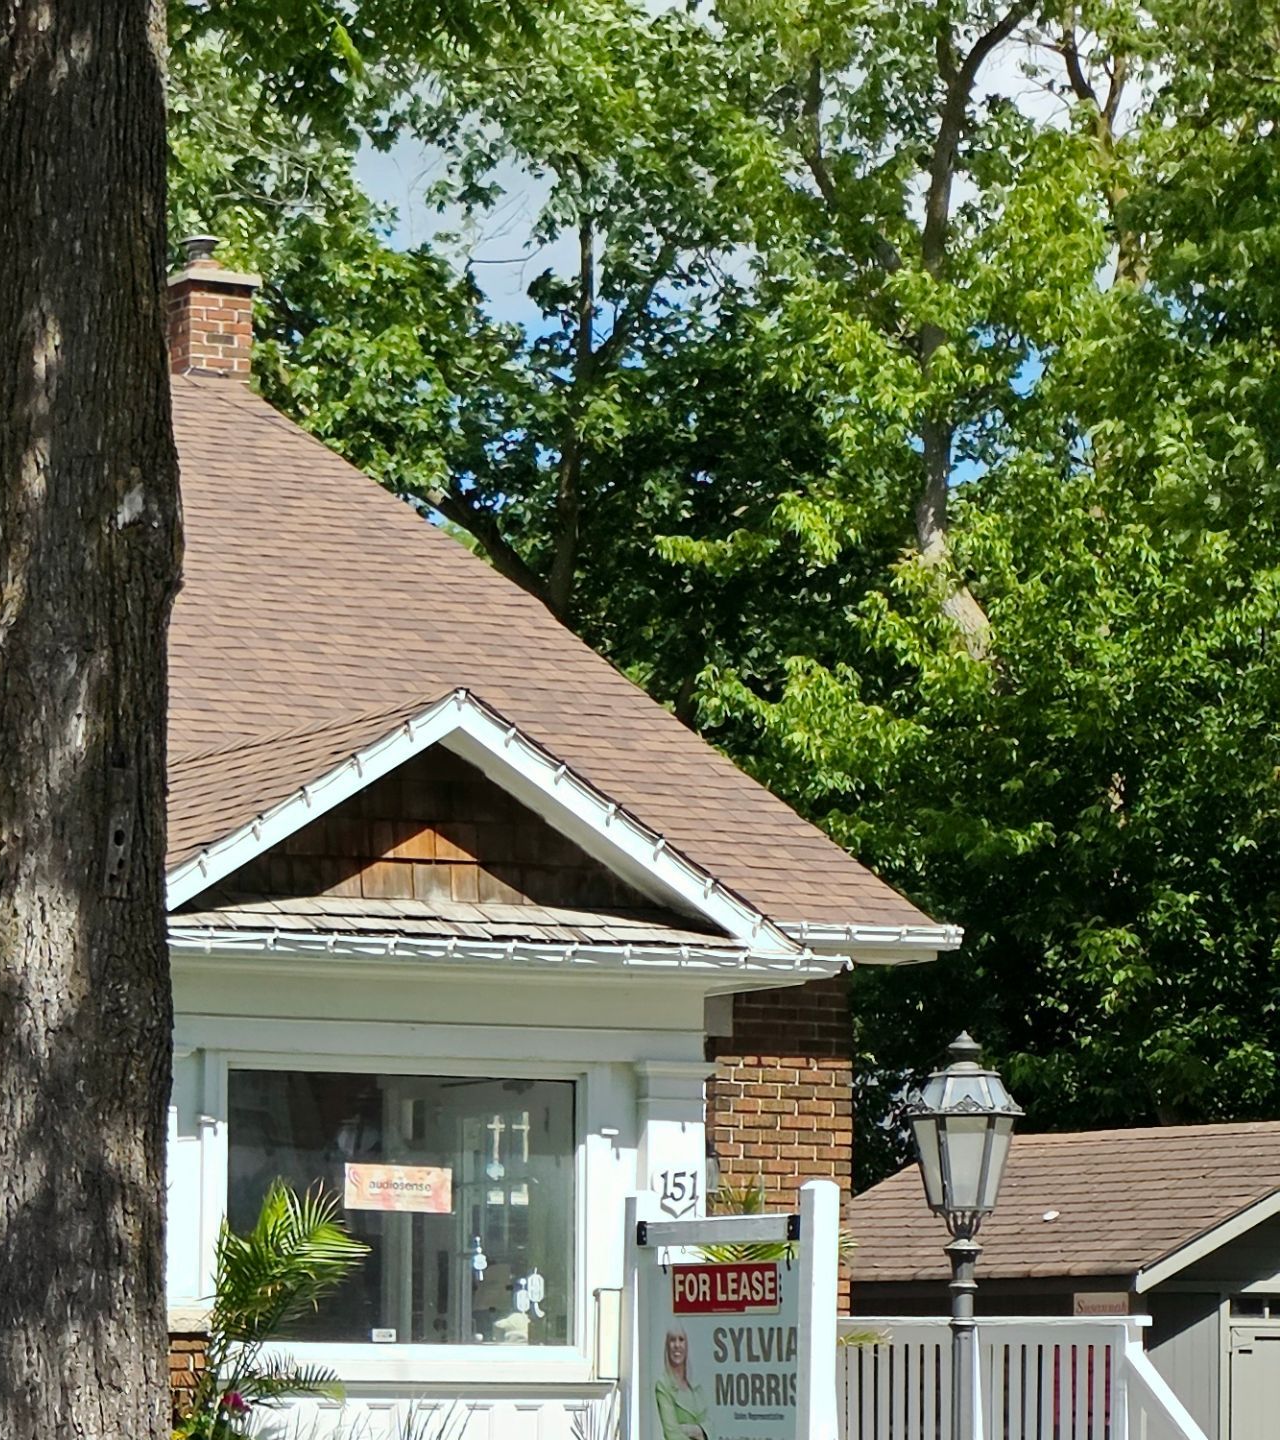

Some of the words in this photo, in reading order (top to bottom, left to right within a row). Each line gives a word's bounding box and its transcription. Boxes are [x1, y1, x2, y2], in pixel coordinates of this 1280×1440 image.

[660, 1170, 698, 1202] 151
[674, 1272, 711, 1302] FOR
[716, 1270, 776, 1301] LEASE
[713, 1326, 798, 1363] SYLVIA
